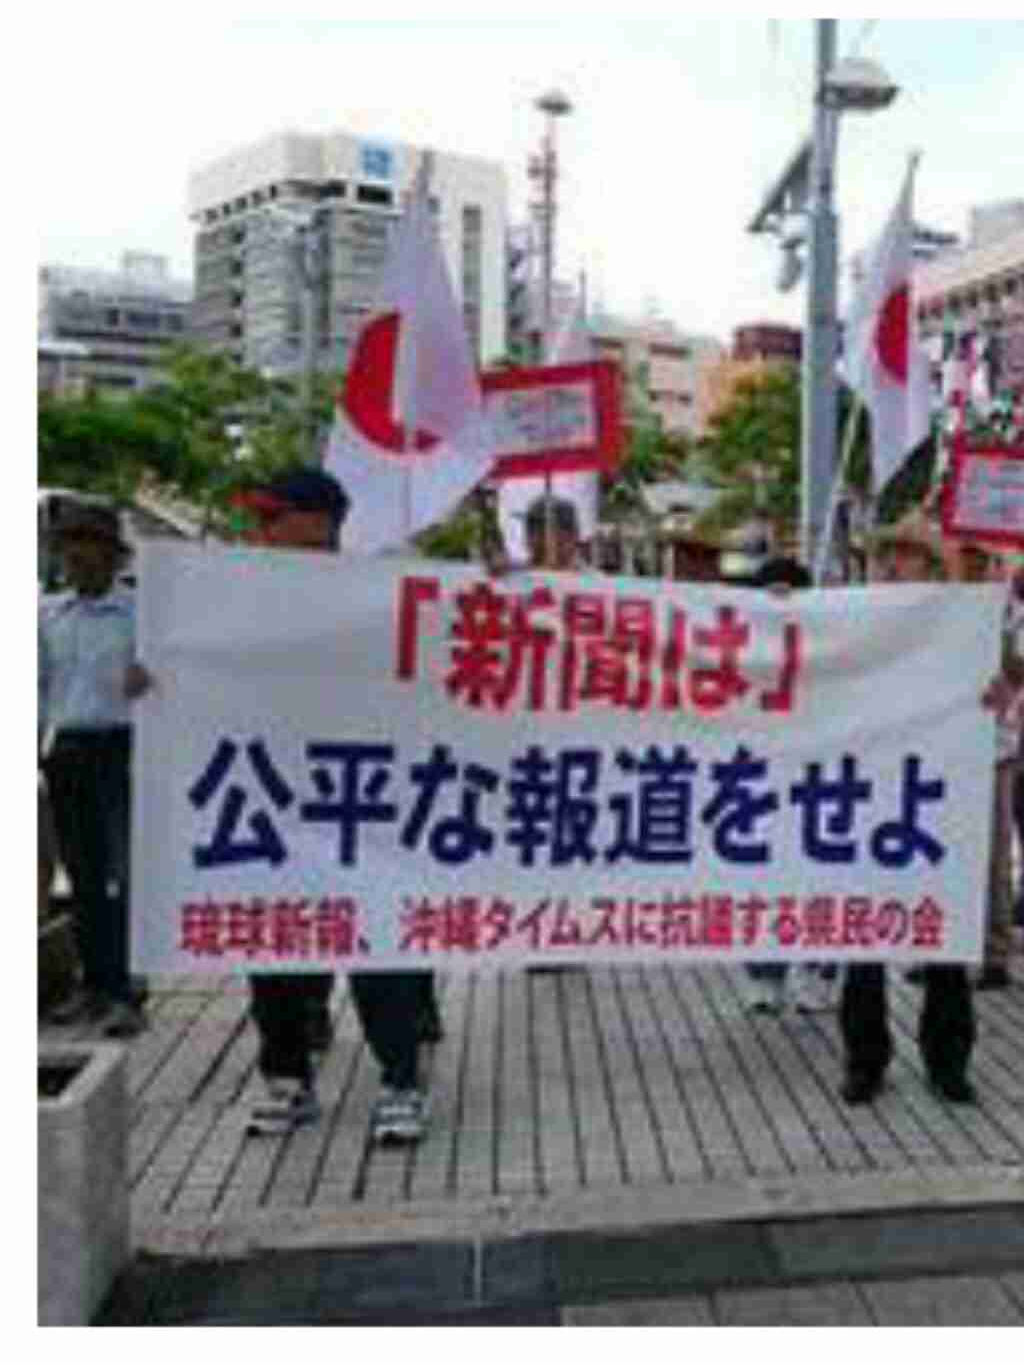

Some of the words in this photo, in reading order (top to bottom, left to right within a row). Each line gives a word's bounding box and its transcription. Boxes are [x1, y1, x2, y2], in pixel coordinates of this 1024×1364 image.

[396, 576, 802, 715] 「新聞は」
[188, 738, 947, 870] 公平な報道をせよ
